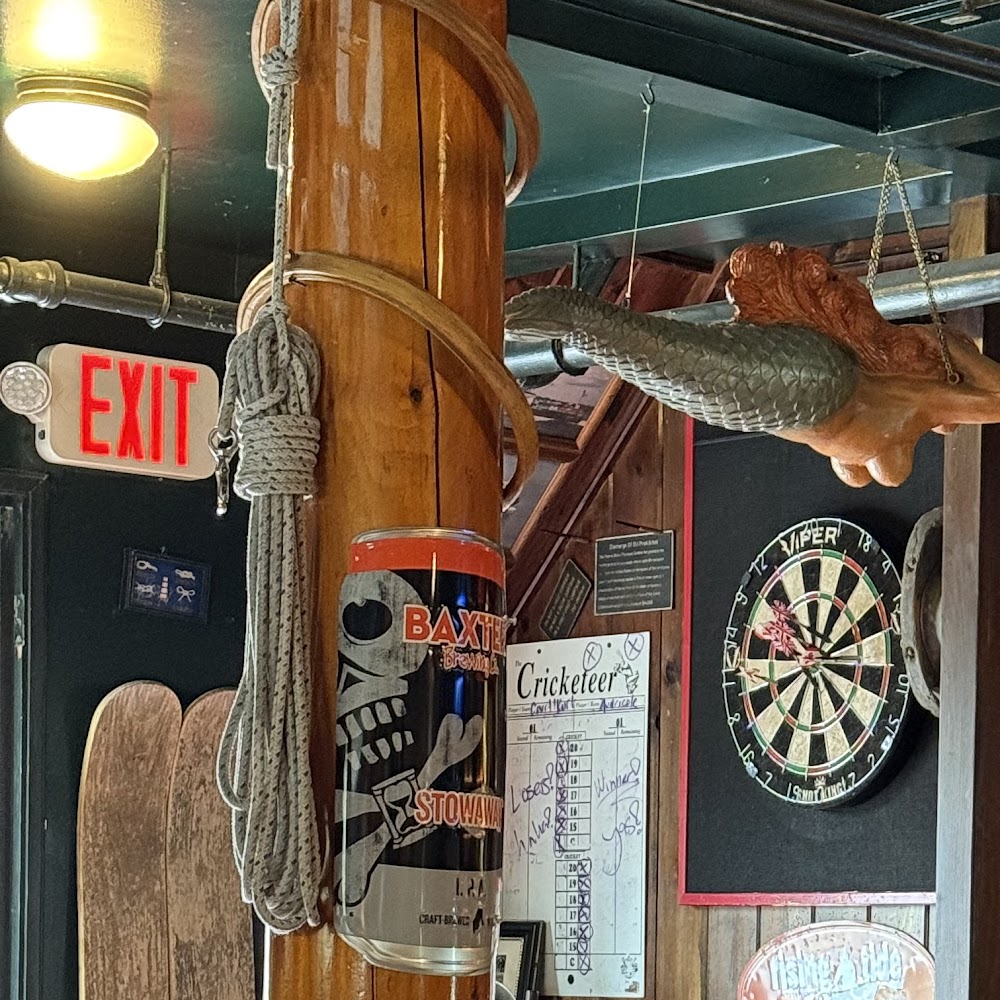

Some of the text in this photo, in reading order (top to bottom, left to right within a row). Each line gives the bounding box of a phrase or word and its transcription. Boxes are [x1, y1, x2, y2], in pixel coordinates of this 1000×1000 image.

[81, 353, 198, 467] EXIT
[779, 526, 837, 557] VIPER
[403, 604, 507, 657] BAXTE
[517, 660, 618, 700] Cricketeer
[568, 863, 577, 873] 20
[569, 880, 577, 889] 19
[569, 910, 577, 918] 17
